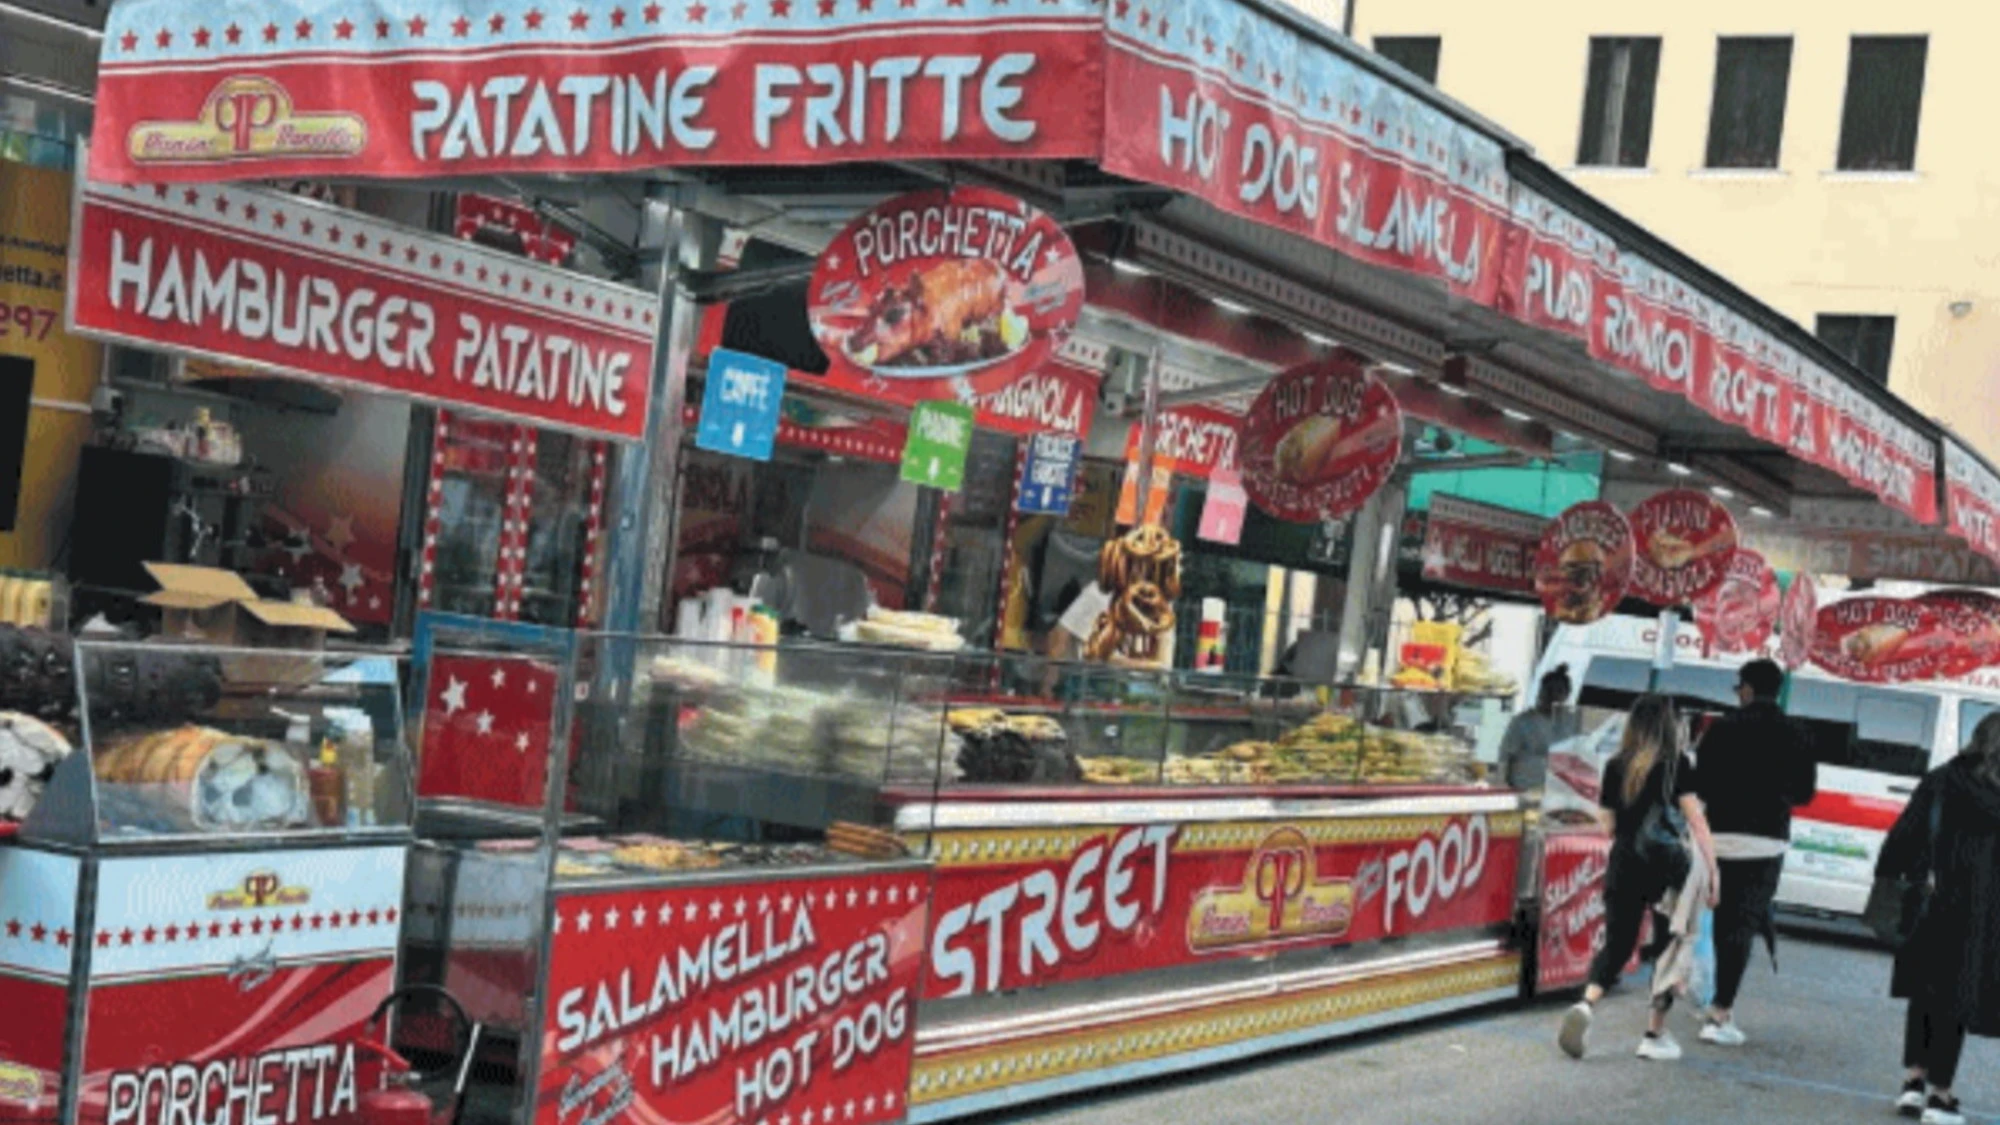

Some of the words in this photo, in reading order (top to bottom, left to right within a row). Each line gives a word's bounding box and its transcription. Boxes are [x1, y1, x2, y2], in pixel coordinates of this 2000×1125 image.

[410, 66, 718, 163] PATATINE
[752, 52, 1037, 149] FRITTE
[1238, 122, 1319, 220] DOG
[853, 206, 1044, 279] PORCHETTA
[109, 227, 436, 376] HAMBURGER
[452, 311, 633, 418] PATATINE
[1276, 376, 1315, 422] HOT
[1321, 376, 1365, 420] DOG
[932, 824, 1178, 998] STREET
[1385, 814, 1488, 936] FOOD
[556, 898, 816, 1054] SALAMELLA
[649, 932, 889, 1087] HAMBURGER
[107, 1042, 358, 1125] PORCHETTA
[735, 1030, 817, 1117] HOT
[833, 987, 906, 1070] DOG
